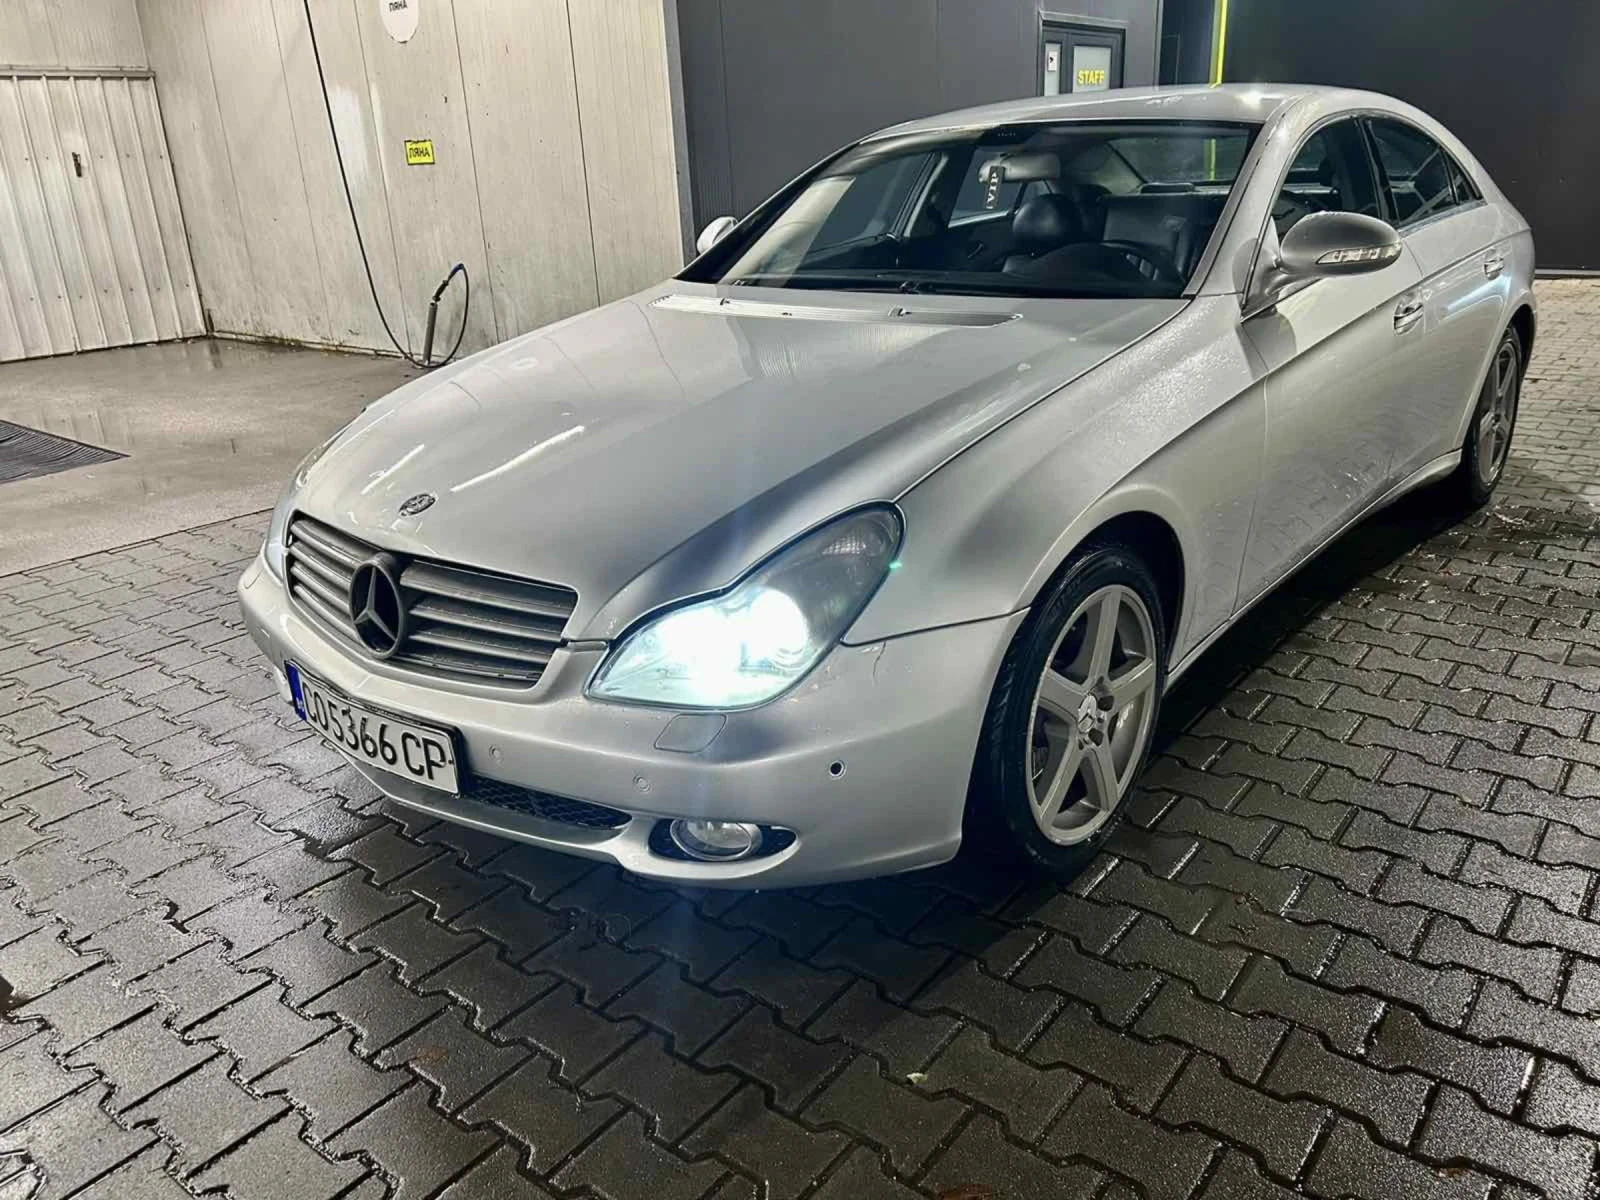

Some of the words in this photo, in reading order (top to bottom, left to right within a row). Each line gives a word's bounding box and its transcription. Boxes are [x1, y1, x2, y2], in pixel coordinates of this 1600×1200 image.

[389, 0, 408, 12] ПЯНА
[1078, 69, 1105, 85] STAFF
[409, 147, 431, 159] ПЯНА
